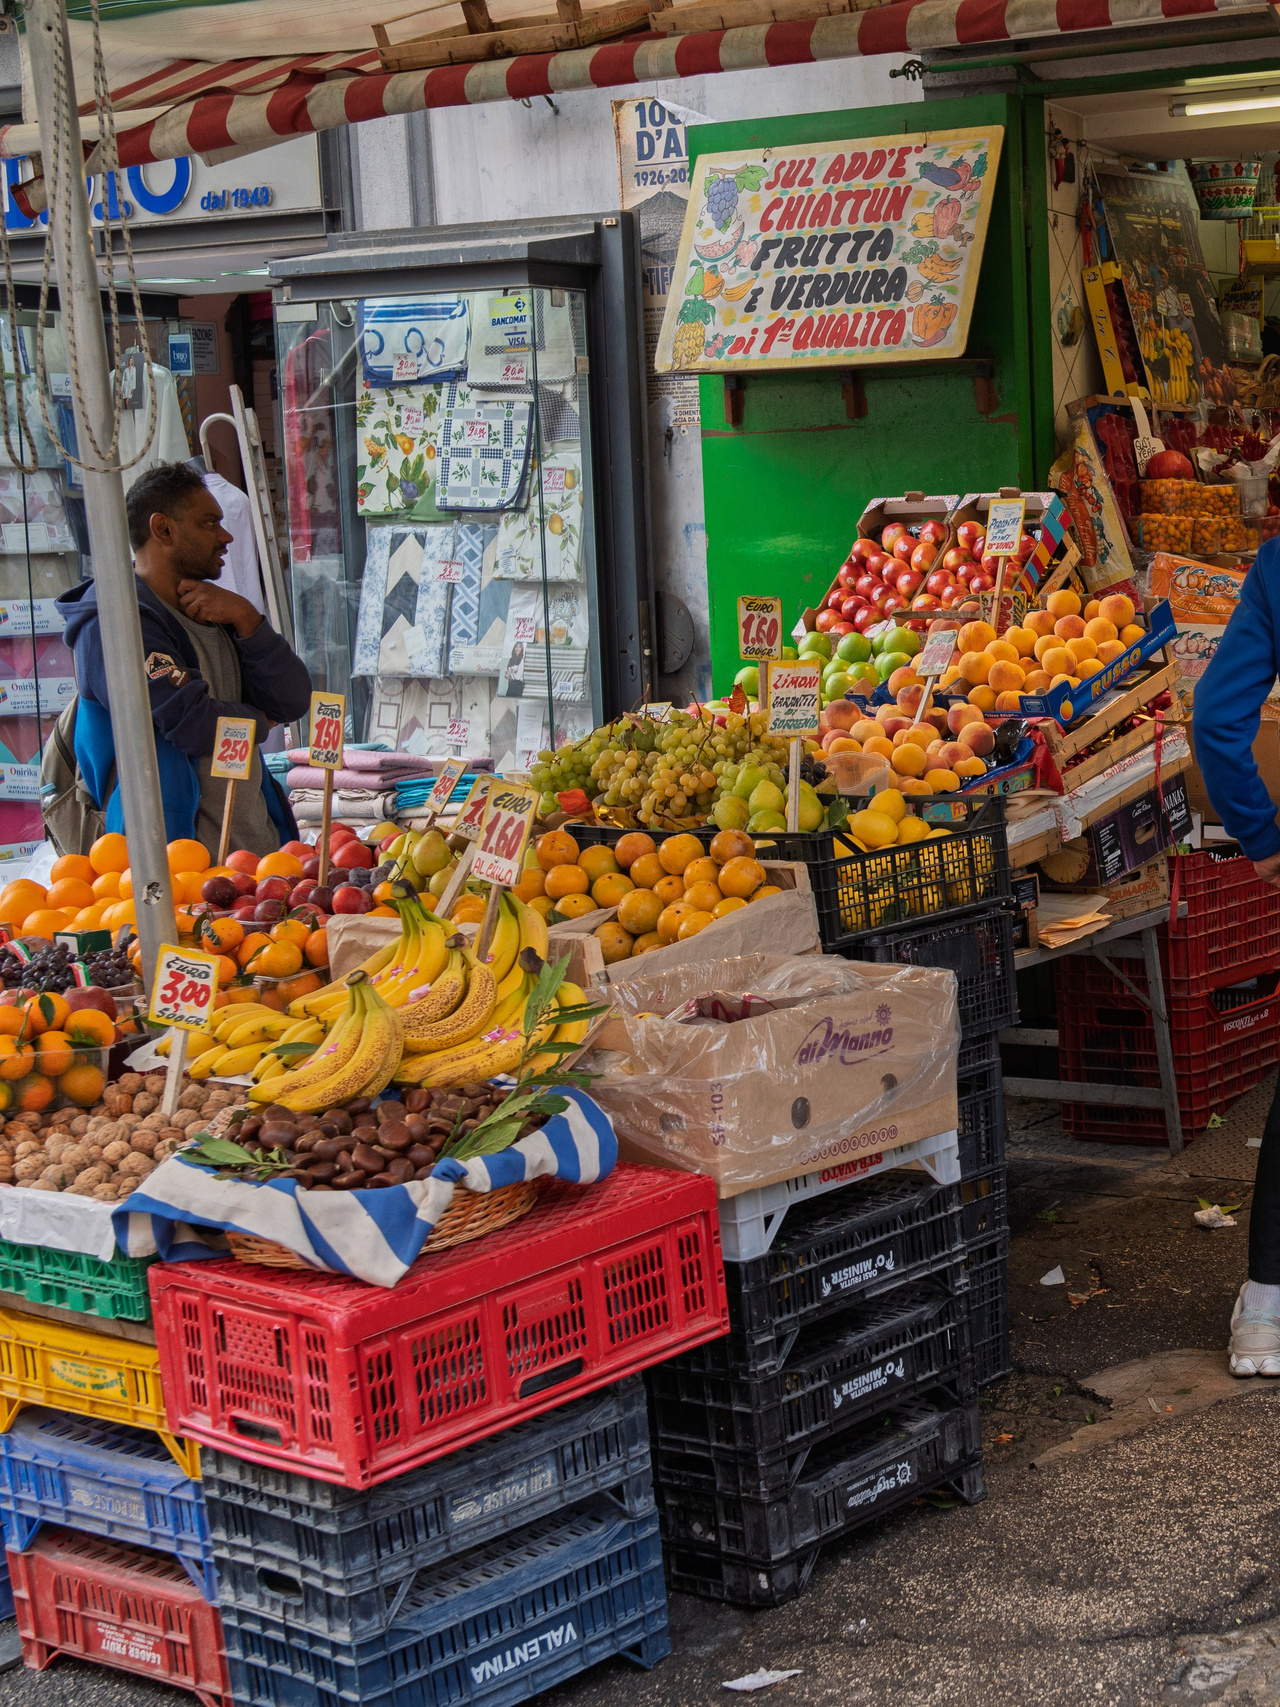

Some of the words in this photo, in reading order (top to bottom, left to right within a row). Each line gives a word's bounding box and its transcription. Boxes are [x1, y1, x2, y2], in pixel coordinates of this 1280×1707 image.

[765, 157, 817, 190] SUL
[200, 189, 228, 211] dal
[231, 186, 272, 208] 1949
[759, 185, 912, 232] CHIATTUN
[751, 228, 894, 271] FRUTTA
[744, 287, 764, 313] E
[770, 267, 907, 310] VERDURA
[491, 314, 527, 327] BANCOMAT
[509, 337, 526, 346] VISA
[745, 601, 775, 614] EURO
[742, 613, 778, 647] 1,60
[1091, 647, 1142, 700] RUSSO
[312, 717, 341, 751] 1,50
[770, 714, 818, 731] SORRENTO
[217, 738, 249, 764] 2,50
[323, 751, 339, 765] 500
[10, 766, 38, 777] Onirika
[493, 792, 533, 814] EURO
[472, 857, 484, 874] AL
[486, 862, 514, 885] CHILO
[160, 970, 211, 1013] 3,00
[822, 1152, 883, 1182] STRAVATO
[831, 1259, 872, 1285] MINISTR
[840, 1275, 861, 1289] FRUTTA
[863, 1269, 877, 1281] OASI
[841, 1367, 881, 1395] MINISTR
[850, 1384, 871, 1400] FRUTTA
[873, 1376, 887, 1388] OASI
[483, 1480, 527, 1514] POLISE
[100, 1638, 127, 1656] FRUIT
[128, 1645, 161, 1665] LEADER
[470, 1622, 577, 1684] VALENTINA
